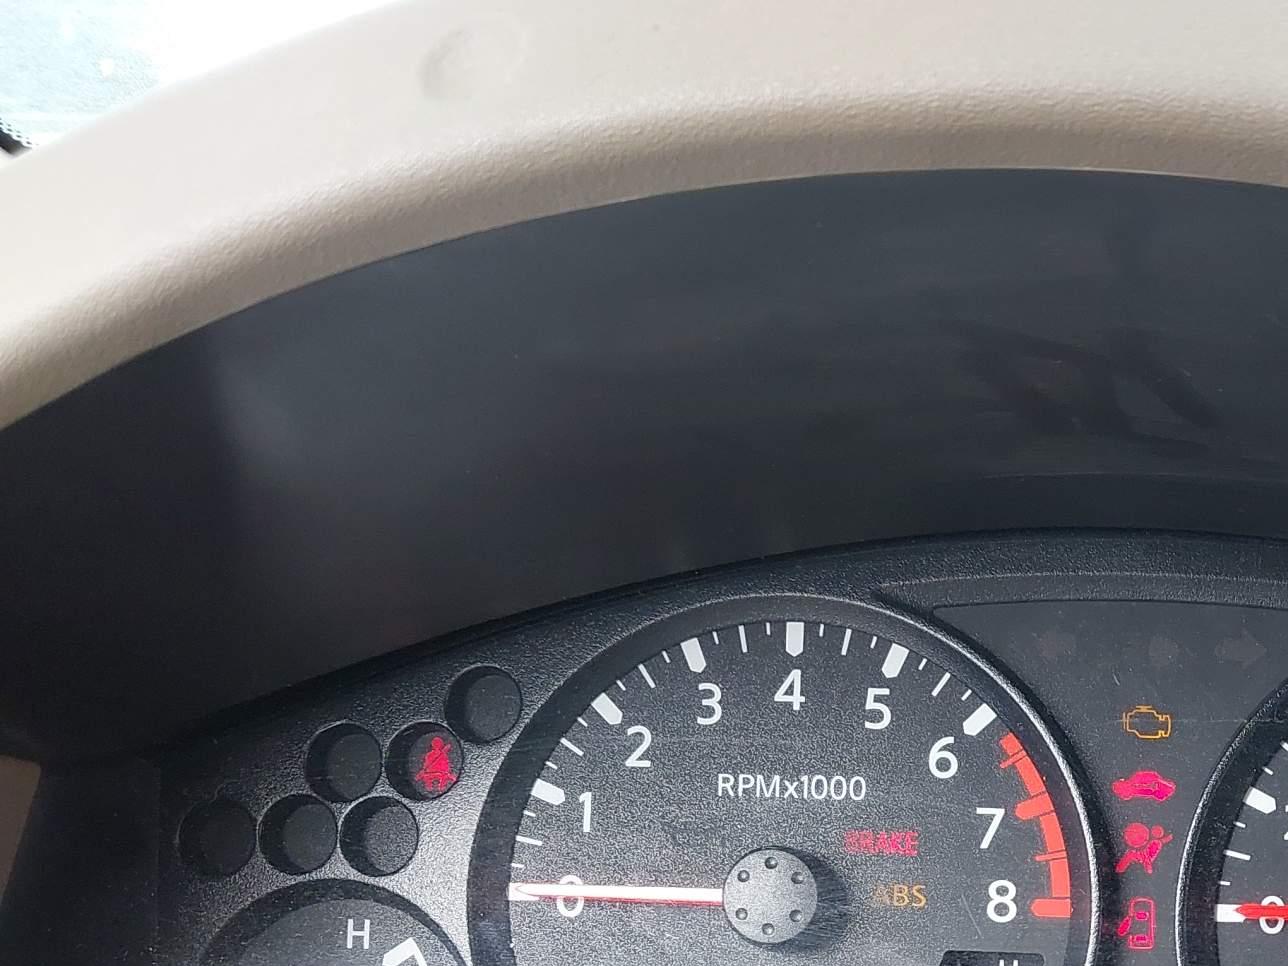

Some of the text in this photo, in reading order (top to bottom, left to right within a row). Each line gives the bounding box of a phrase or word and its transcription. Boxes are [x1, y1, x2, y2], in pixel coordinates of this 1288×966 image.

[697, 684, 721, 725] 3
[774, 669, 805, 710] 4
[866, 688, 891, 729] 5
[626, 727, 652, 767] 2
[928, 737, 958, 778] 6
[717, 773, 866, 801] RPMx1000
[581, 792, 592, 832] 1
[976, 808, 1003, 849] 7
[845, 831, 919, 856] BRAKE
[556, 875, 584, 918] 0
[987, 880, 1016, 922] 8
[1258, 896, 1284, 935] 0
[347, 919, 369, 949] H
